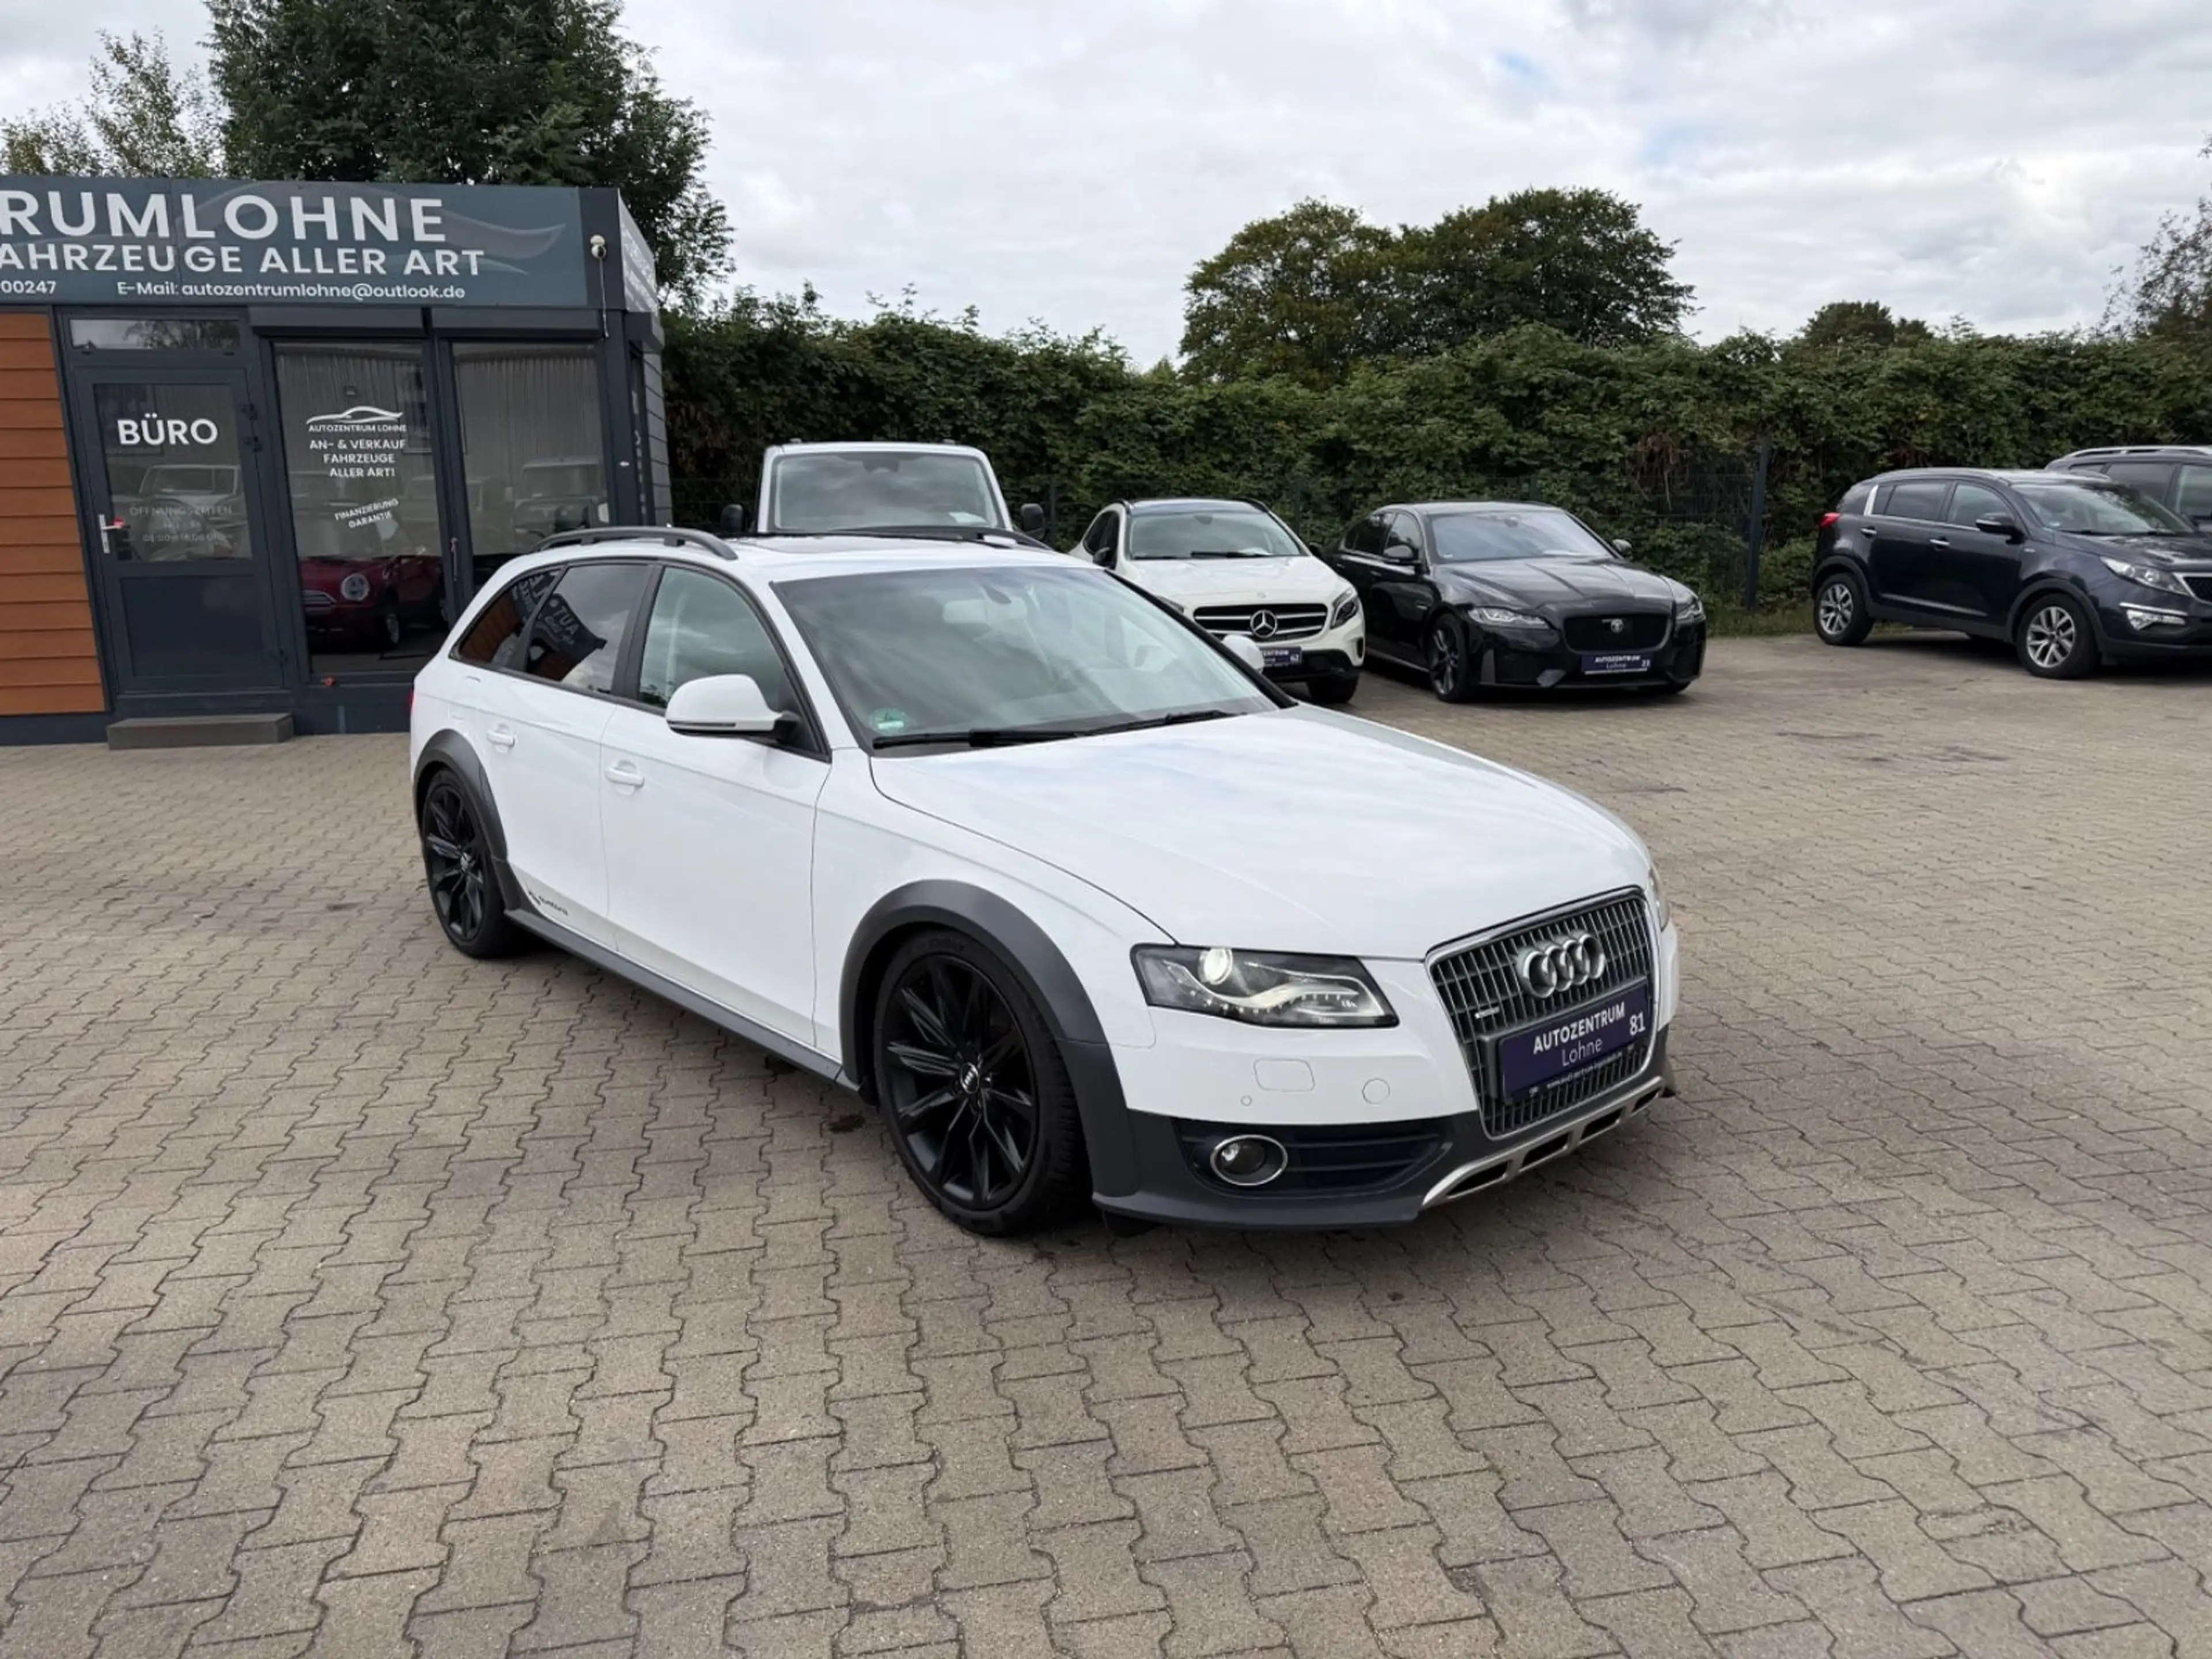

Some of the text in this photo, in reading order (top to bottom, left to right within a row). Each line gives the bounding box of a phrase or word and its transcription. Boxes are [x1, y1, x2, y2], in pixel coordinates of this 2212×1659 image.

[0, 190, 446, 242] RUMLOHNE
[0, 243, 484, 275] AHRZEUGE ALLER ART
[1, 280, 465, 302] 00247 E-Mail: autozentrumlohne@outlook.de
[117, 412, 218, 446] BÜRO
[308, 424, 407, 432] AUTOZENTRUM LOHNE
[309, 439, 406, 450] AN- & VERKAUF
[323, 453, 395, 464] FAHRZEUGE
[330, 467, 364, 478] ALLER
[1533, 1001, 1625, 1055] AUTOZENTRUM
[1629, 1012, 1646, 1036] 81
[1562, 1038, 1603, 1067] Lohne
